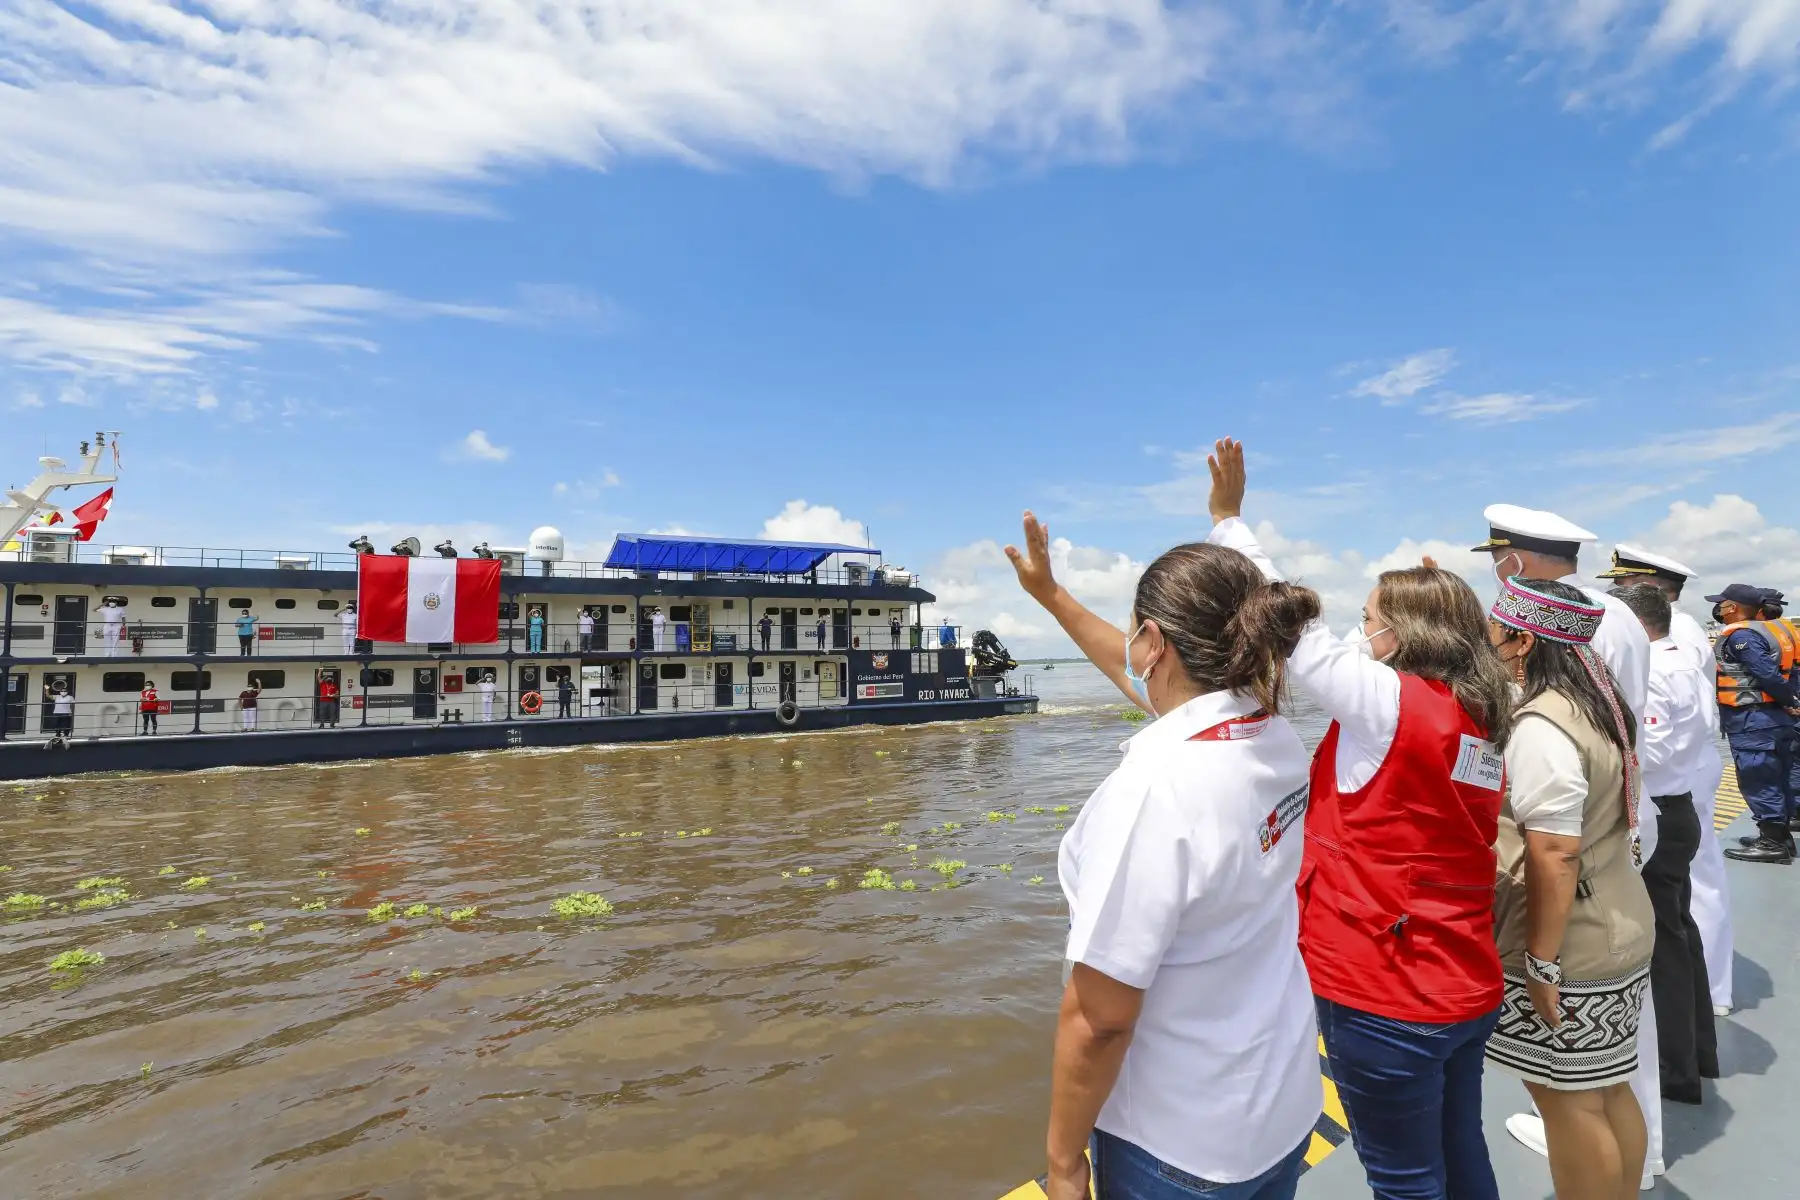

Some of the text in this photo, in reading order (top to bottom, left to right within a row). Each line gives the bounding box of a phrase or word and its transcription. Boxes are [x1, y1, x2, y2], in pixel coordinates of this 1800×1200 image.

[918, 688, 970, 700] RIO YAVARI
[1480, 752, 1503, 772] Siempre
